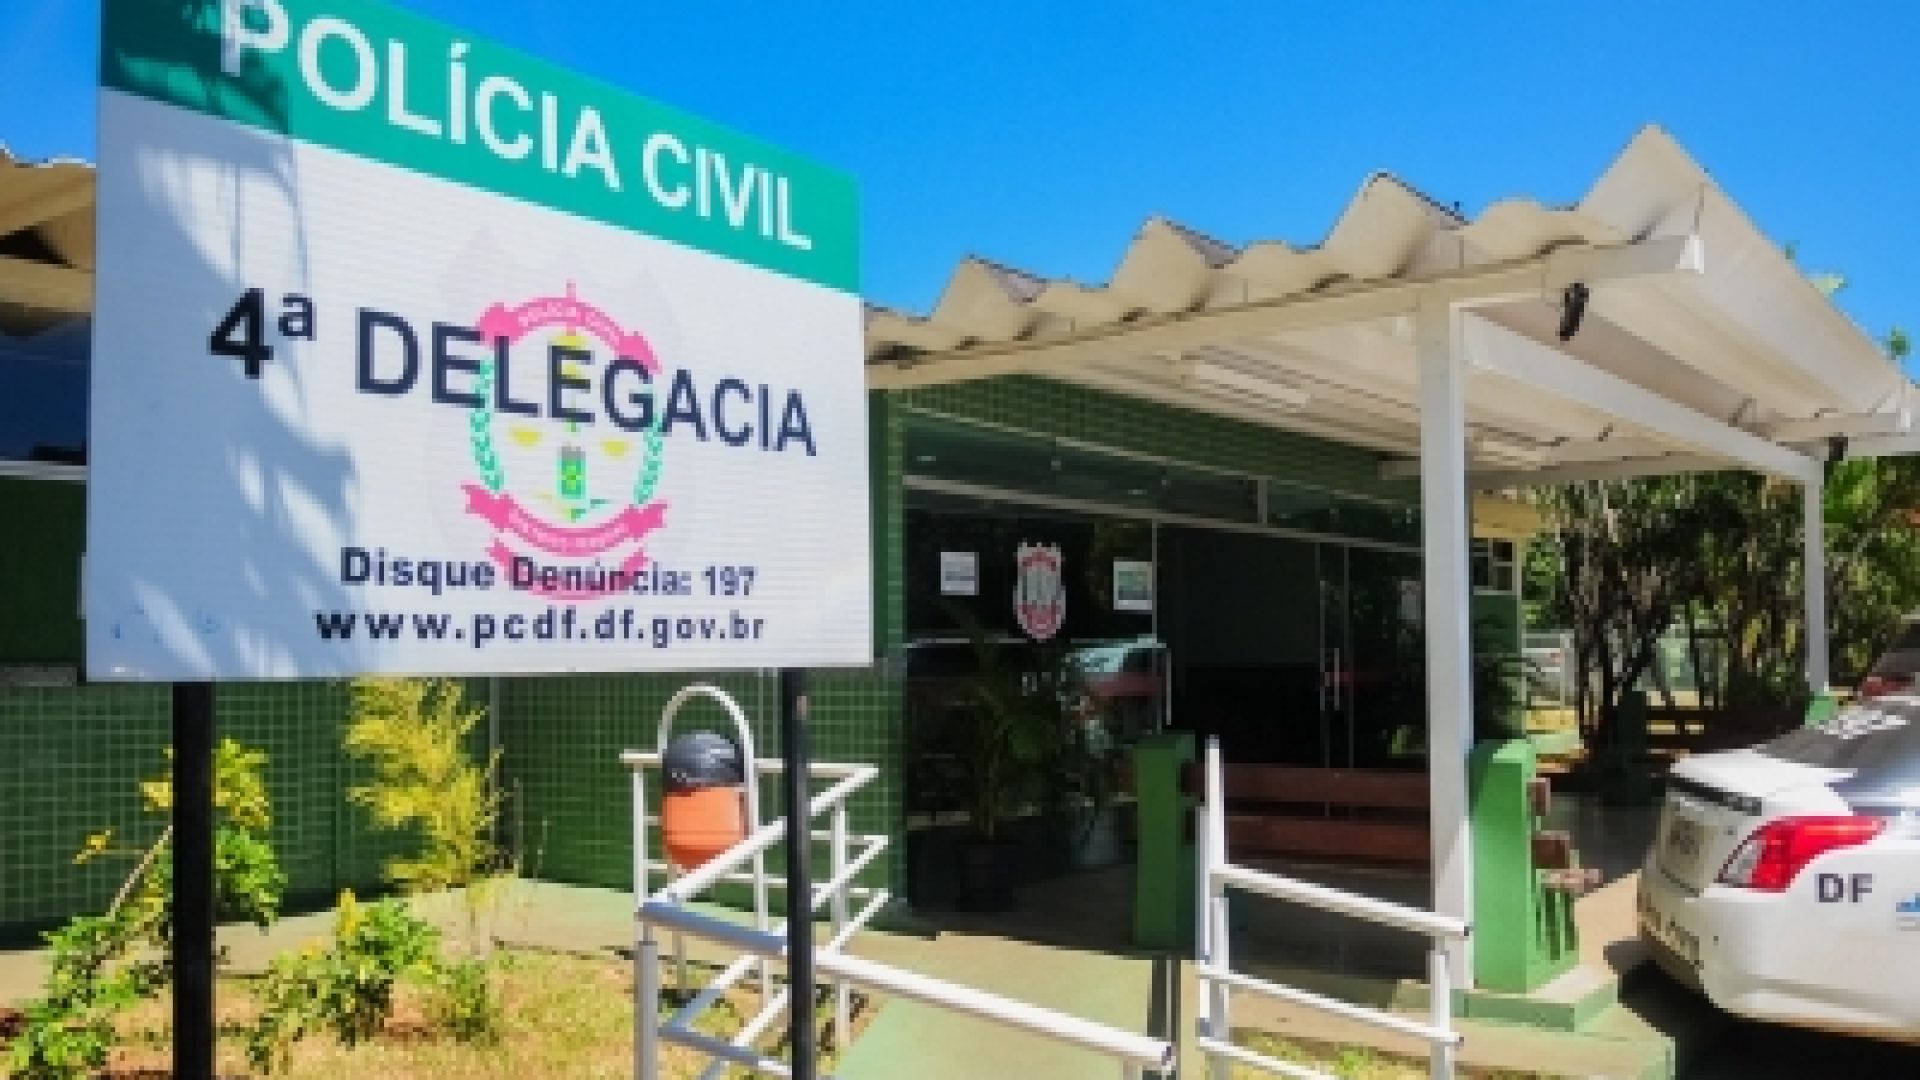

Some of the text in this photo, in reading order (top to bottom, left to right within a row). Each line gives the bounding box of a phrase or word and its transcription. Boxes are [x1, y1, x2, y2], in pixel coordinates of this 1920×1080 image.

[221, 0, 813, 249] POLÍCIA CIVIL
[356, 308, 817, 455] DELEGACIA
[341, 547, 757, 596] Disque Denúncia: 197
[316, 608, 766, 648] www.pcdf.df.gov.br
[1816, 873, 1873, 903] DF
